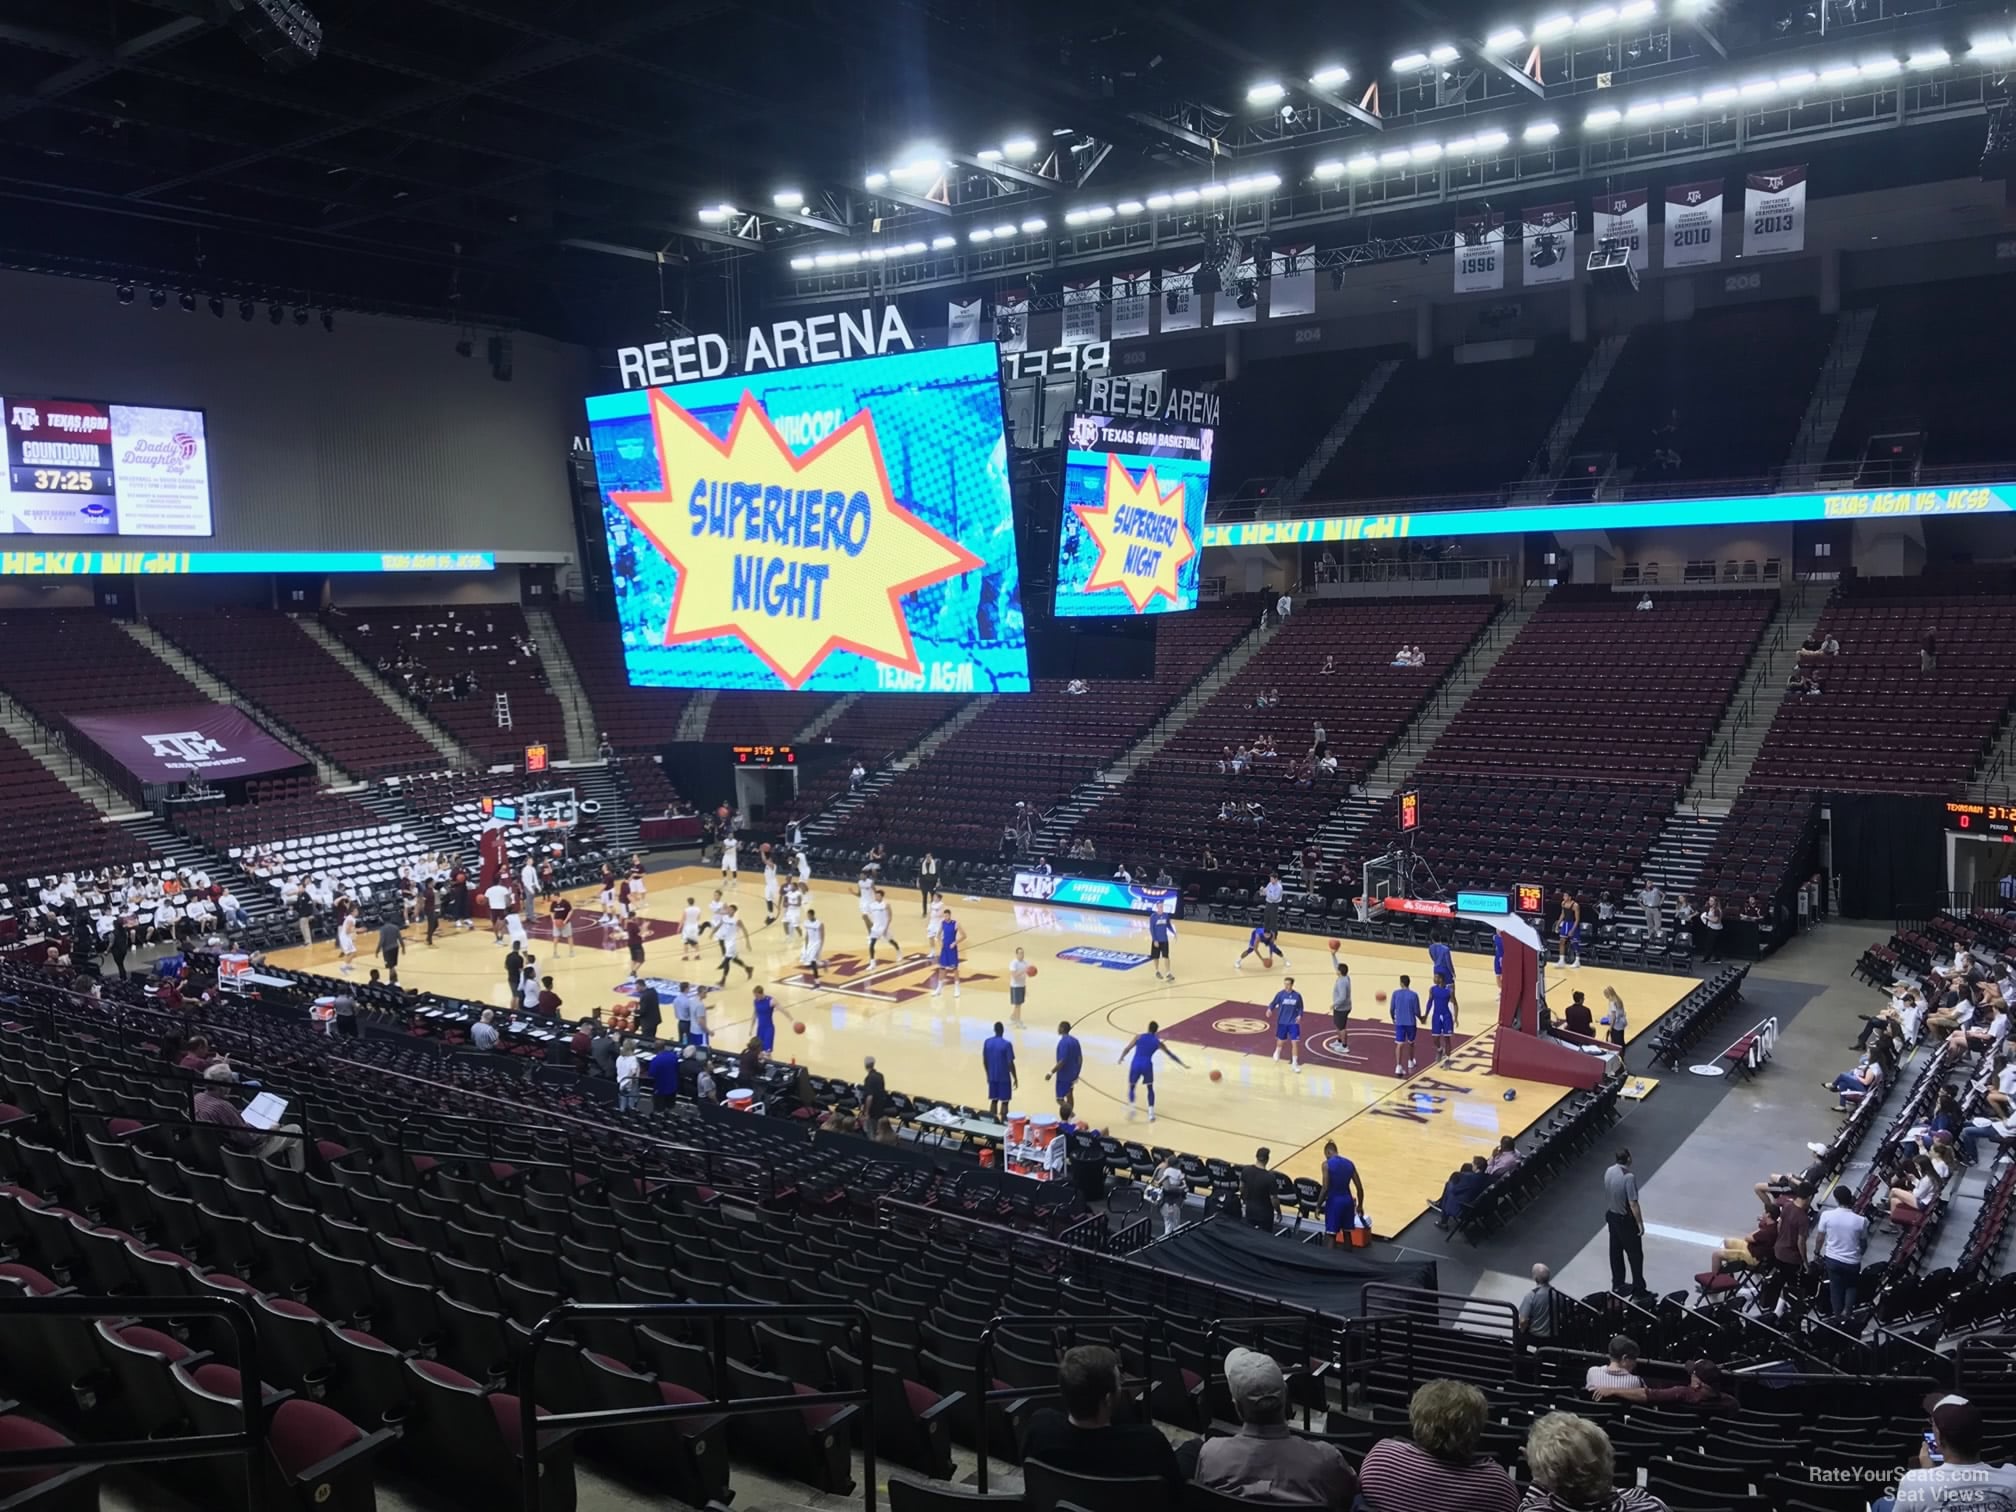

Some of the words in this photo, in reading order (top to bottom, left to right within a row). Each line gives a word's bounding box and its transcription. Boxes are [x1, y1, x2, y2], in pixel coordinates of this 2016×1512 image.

[1754, 214, 1793, 235] 2013
[1674, 228, 1711, 247] 2010
[1462, 257, 1496, 274] 1996
[617, 333, 730, 389] REED
[744, 304, 914, 371] ARENA
[1089, 378, 1162, 418] REED
[1164, 388, 1220, 426] ARENA
[47, 413, 82, 428] TEXAS
[82, 416, 109, 430] A&M
[134, 439, 178, 455] Daddy
[1102, 428, 1134, 444] TEXAS
[1135, 431, 1157, 445] A&M
[1158, 435, 1201, 451] BASKETBALL
[22, 441, 98, 461] COUNTDOWN
[122, 450, 183, 468] Daughter
[34, 469, 93, 491] 37:25
[166, 465, 184, 476] Day
[1825, 495, 1868, 515] TEXAS
[1872, 493, 1911, 513] A&M
[1946, 488, 1991, 510] UCSB
[688, 478, 872, 557] SUPERHERO
[1114, 504, 1178, 548] SUPERHERO
[1323, 515, 1410, 542] NIGHT
[1122, 544, 1161, 578] NIGHT
[732, 554, 830, 620] NIGHT
[929, 661, 974, 692] A&M
[740, 753, 746, 762] 0
[1404, 807, 1415, 826] 30
[1960, 815, 1969, 828] 0
[1989, 823, 2009, 831] PERIOD
[1519, 887, 1541, 899] 37:25
[1523, 898, 1538, 909] 30
